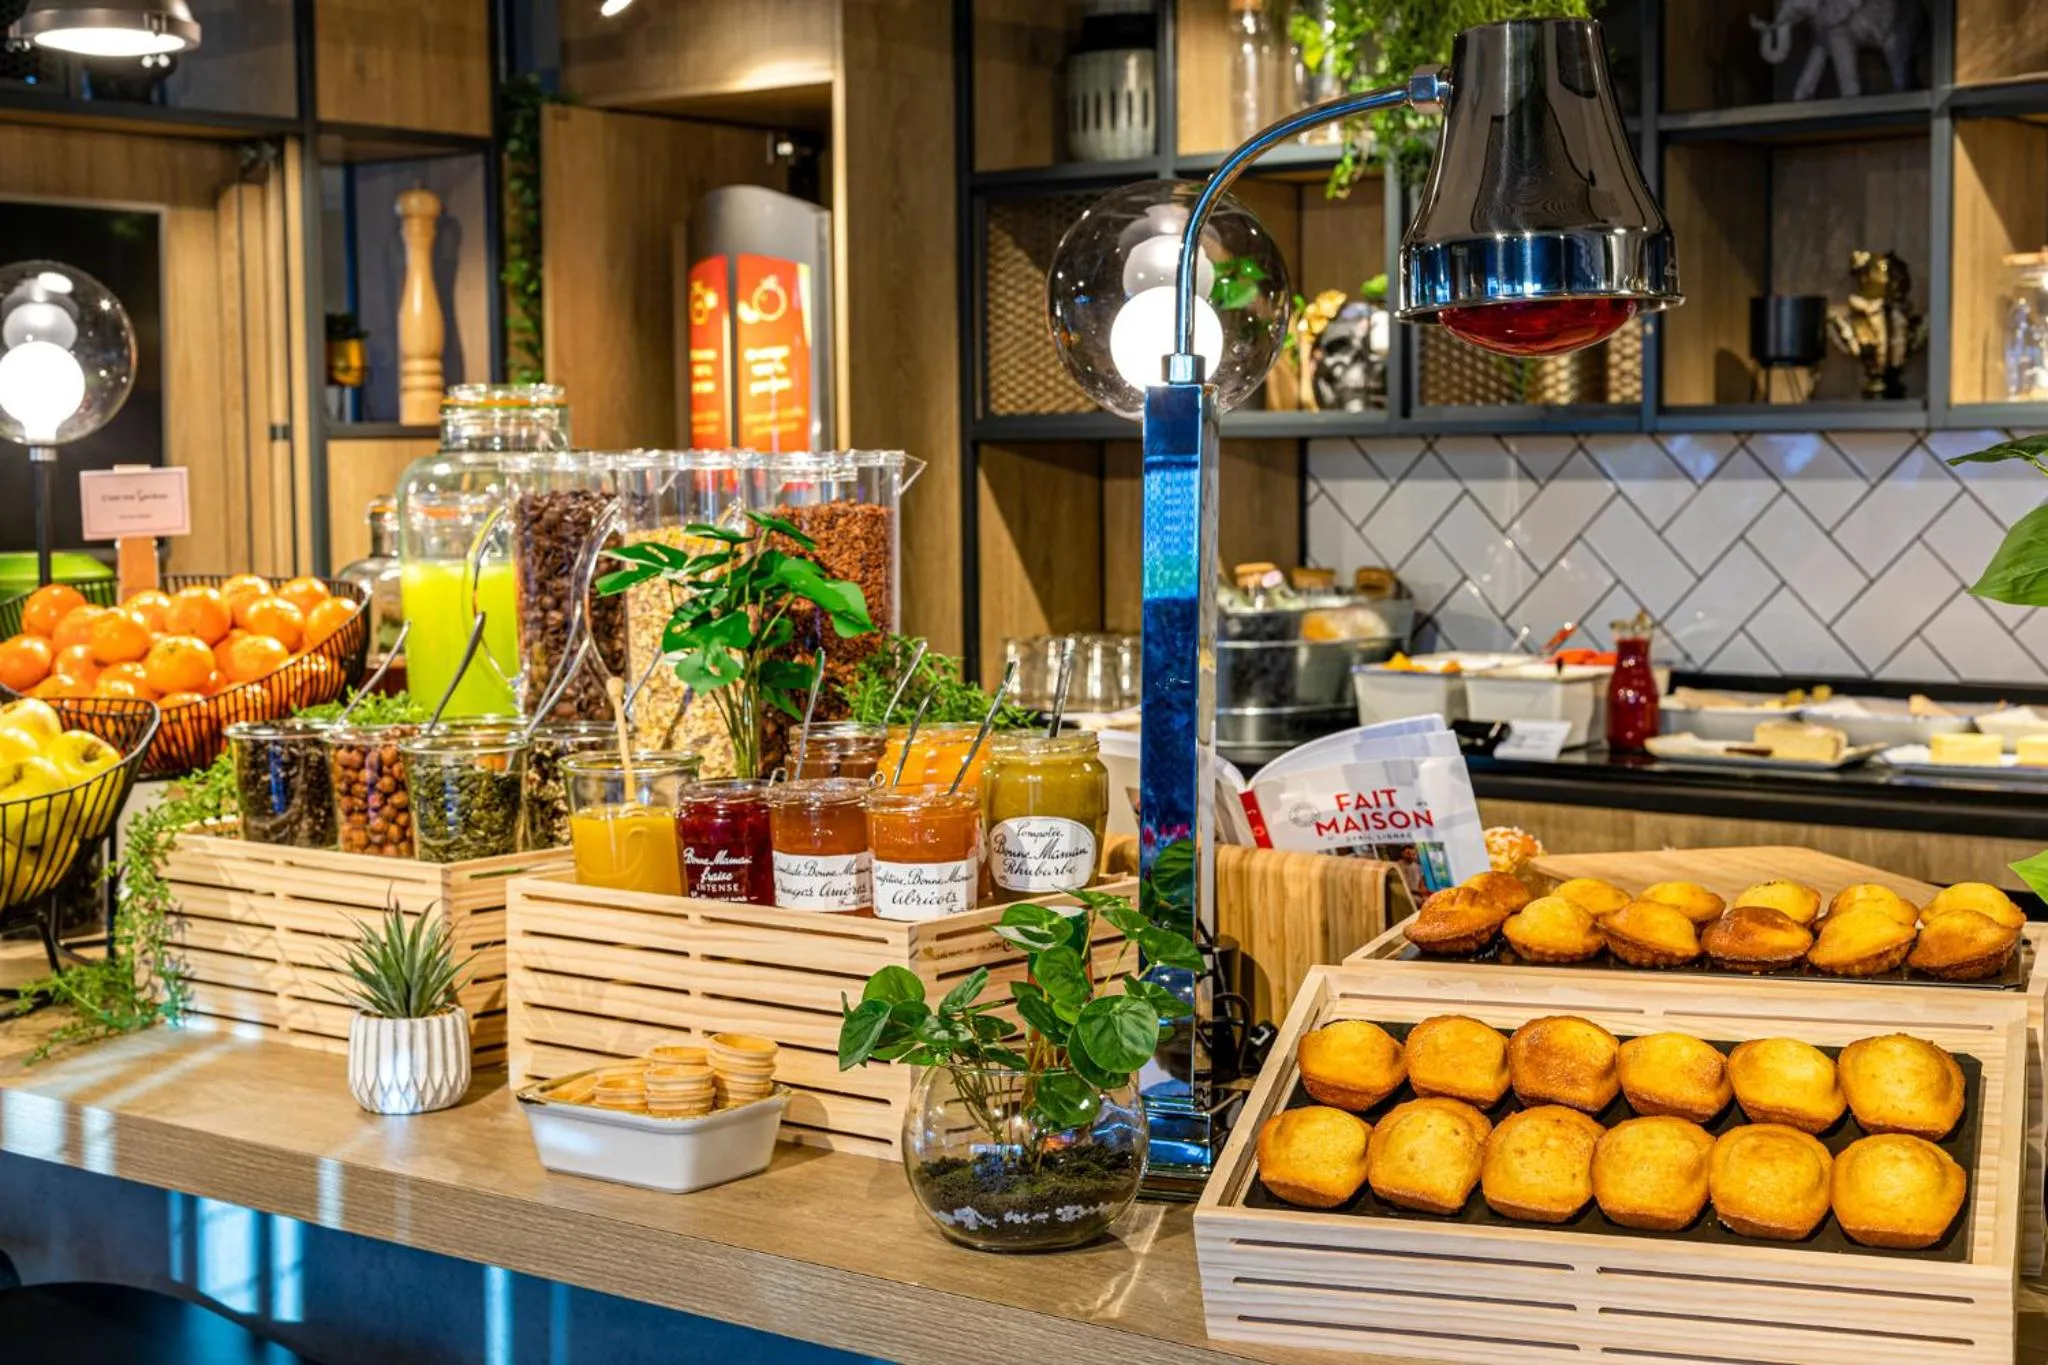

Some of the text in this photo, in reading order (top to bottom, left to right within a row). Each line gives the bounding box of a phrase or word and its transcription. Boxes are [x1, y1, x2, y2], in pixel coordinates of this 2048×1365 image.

[1334, 789, 1397, 812] FAIT
[1314, 809, 1434, 837] MAISON
[993, 832, 1089, 859] Bonne Maman
[683, 847, 714, 866] Bonne
[804, 859, 840, 877] Bonne
[1003, 858, 1078, 876] Rhubarbe
[906, 868, 944, 885] Bonne
[695, 883, 740, 893] INTENSE
[892, 888, 958, 906] Abricots
